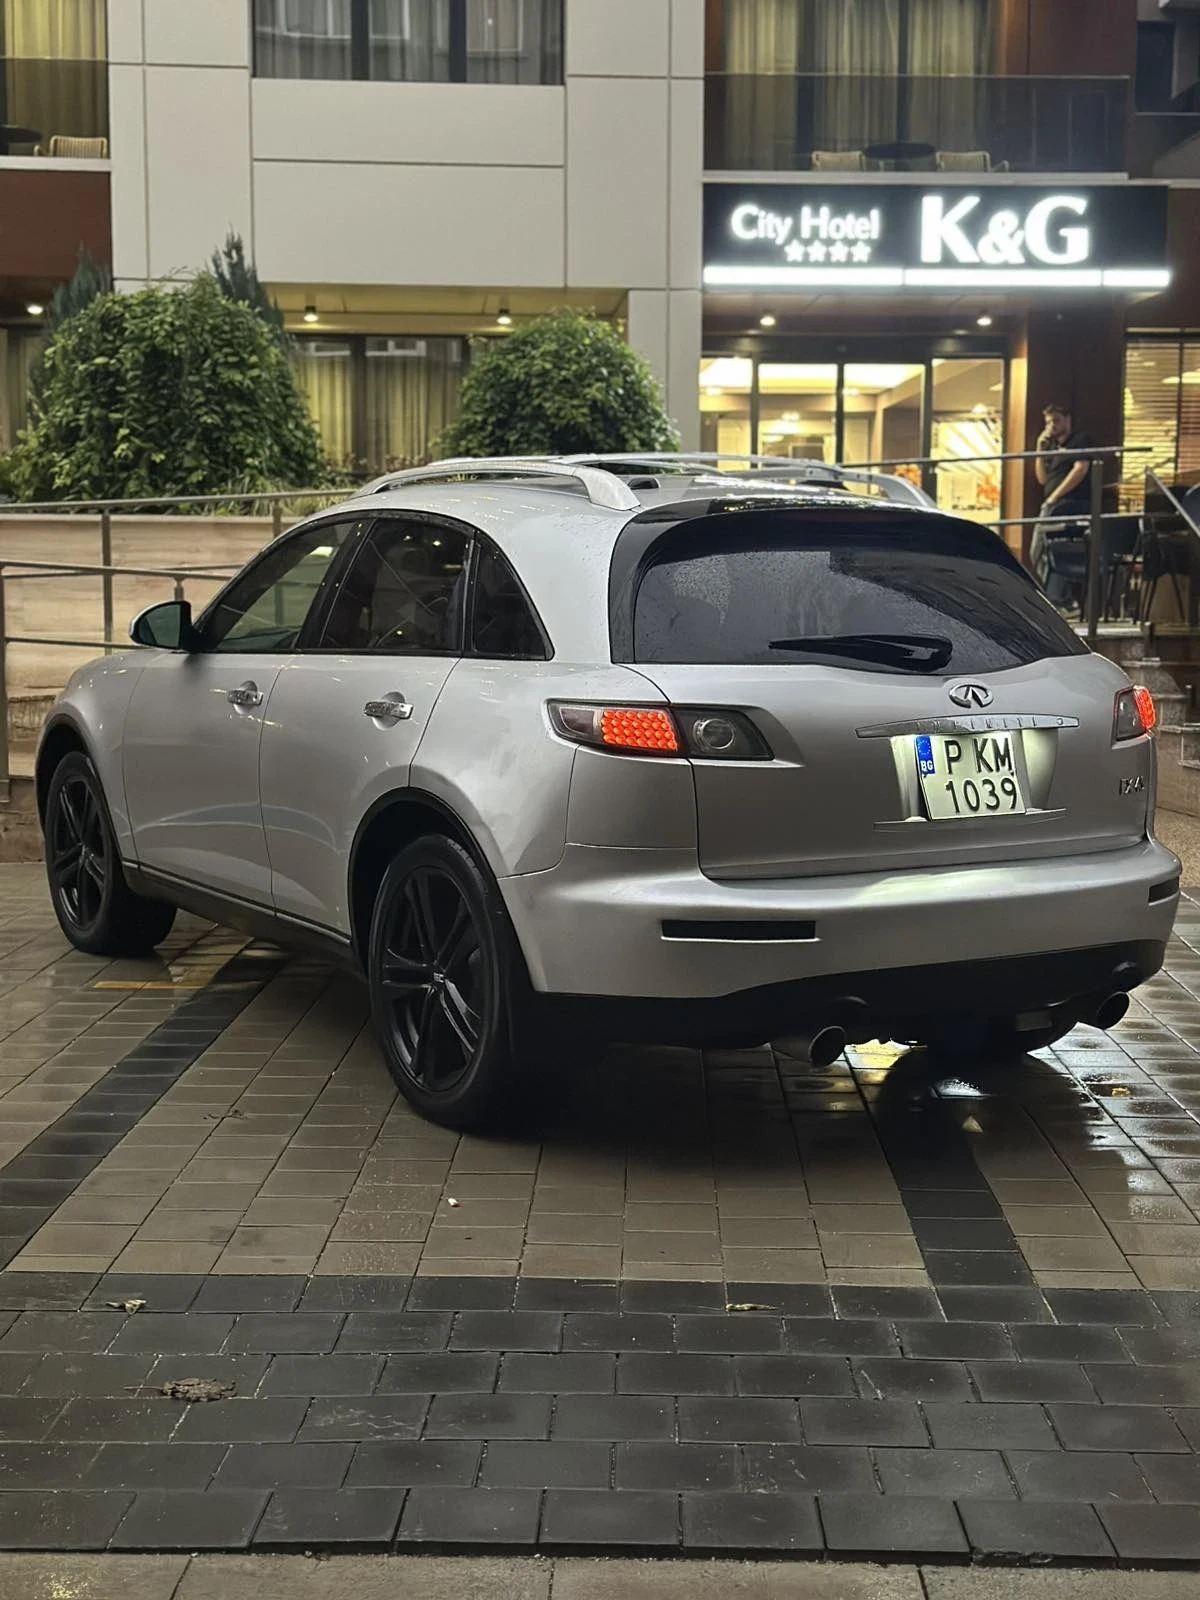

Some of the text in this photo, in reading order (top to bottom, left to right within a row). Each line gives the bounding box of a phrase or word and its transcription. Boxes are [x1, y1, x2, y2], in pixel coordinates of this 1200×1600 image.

[730, 204, 880, 243] City Hotel
[921, 195, 1090, 264] K&G
[920, 760, 933, 771] BG
[944, 737, 1013, 775] P KM
[945, 777, 1017, 814] 1039
